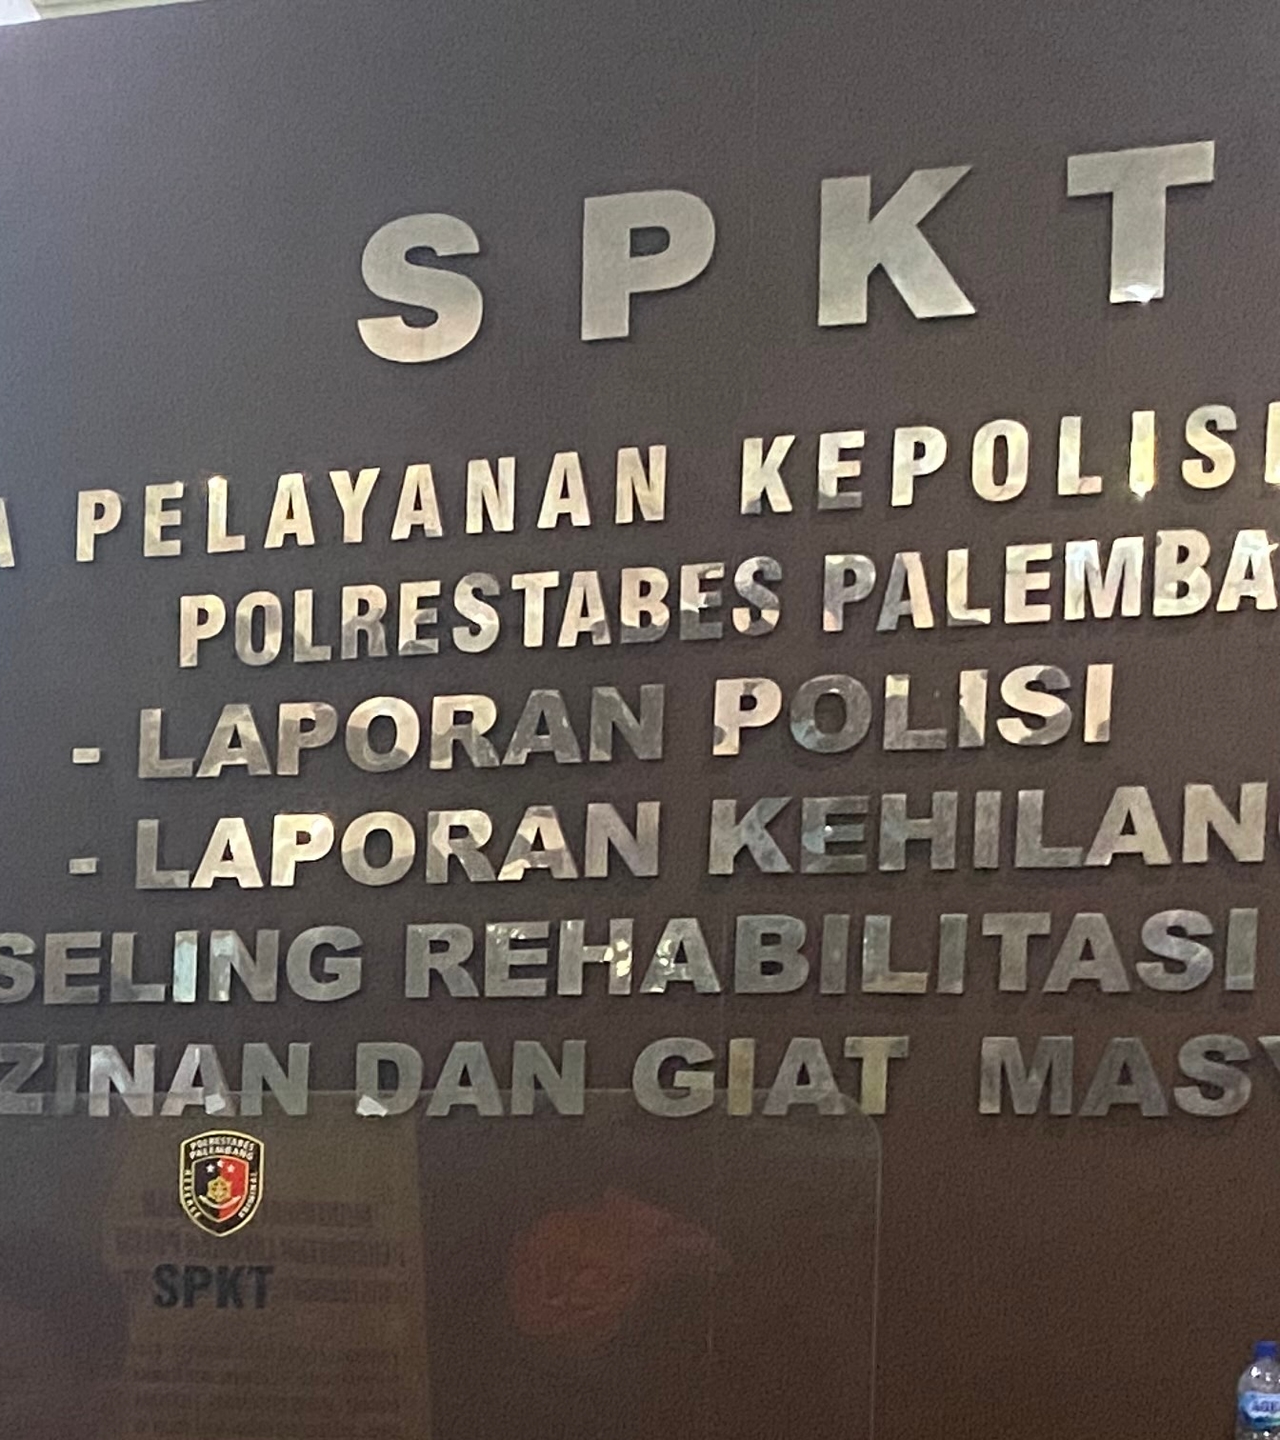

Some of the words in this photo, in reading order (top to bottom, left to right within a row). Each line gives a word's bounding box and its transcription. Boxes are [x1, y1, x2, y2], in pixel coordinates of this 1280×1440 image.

[357, 140, 1215, 363] SPKT
[76, 444, 668, 563] PELAYANAN
[180, 556, 782, 668] POLRESTABES
[822, 528, 1279, 633] PALEMBA
[138, 684, 665, 779] LAPORAN
[713, 663, 1114, 755] POLISI
[136, 801, 660, 890] LAPORAN
[709, 782, 1280, 874] KEHILAN
[404, 908, 1258, 998] REHABILITASI
[355, 1040, 587, 1118] DAN
[633, 1036, 909, 1118] GIAT
[979, 1034, 1280, 1118] MAS
[189, 1146, 254, 1161] PALEMBANG
[190, 1136, 255, 1151] POLRESTABES
[153, 1263, 275, 1309] SPKT
